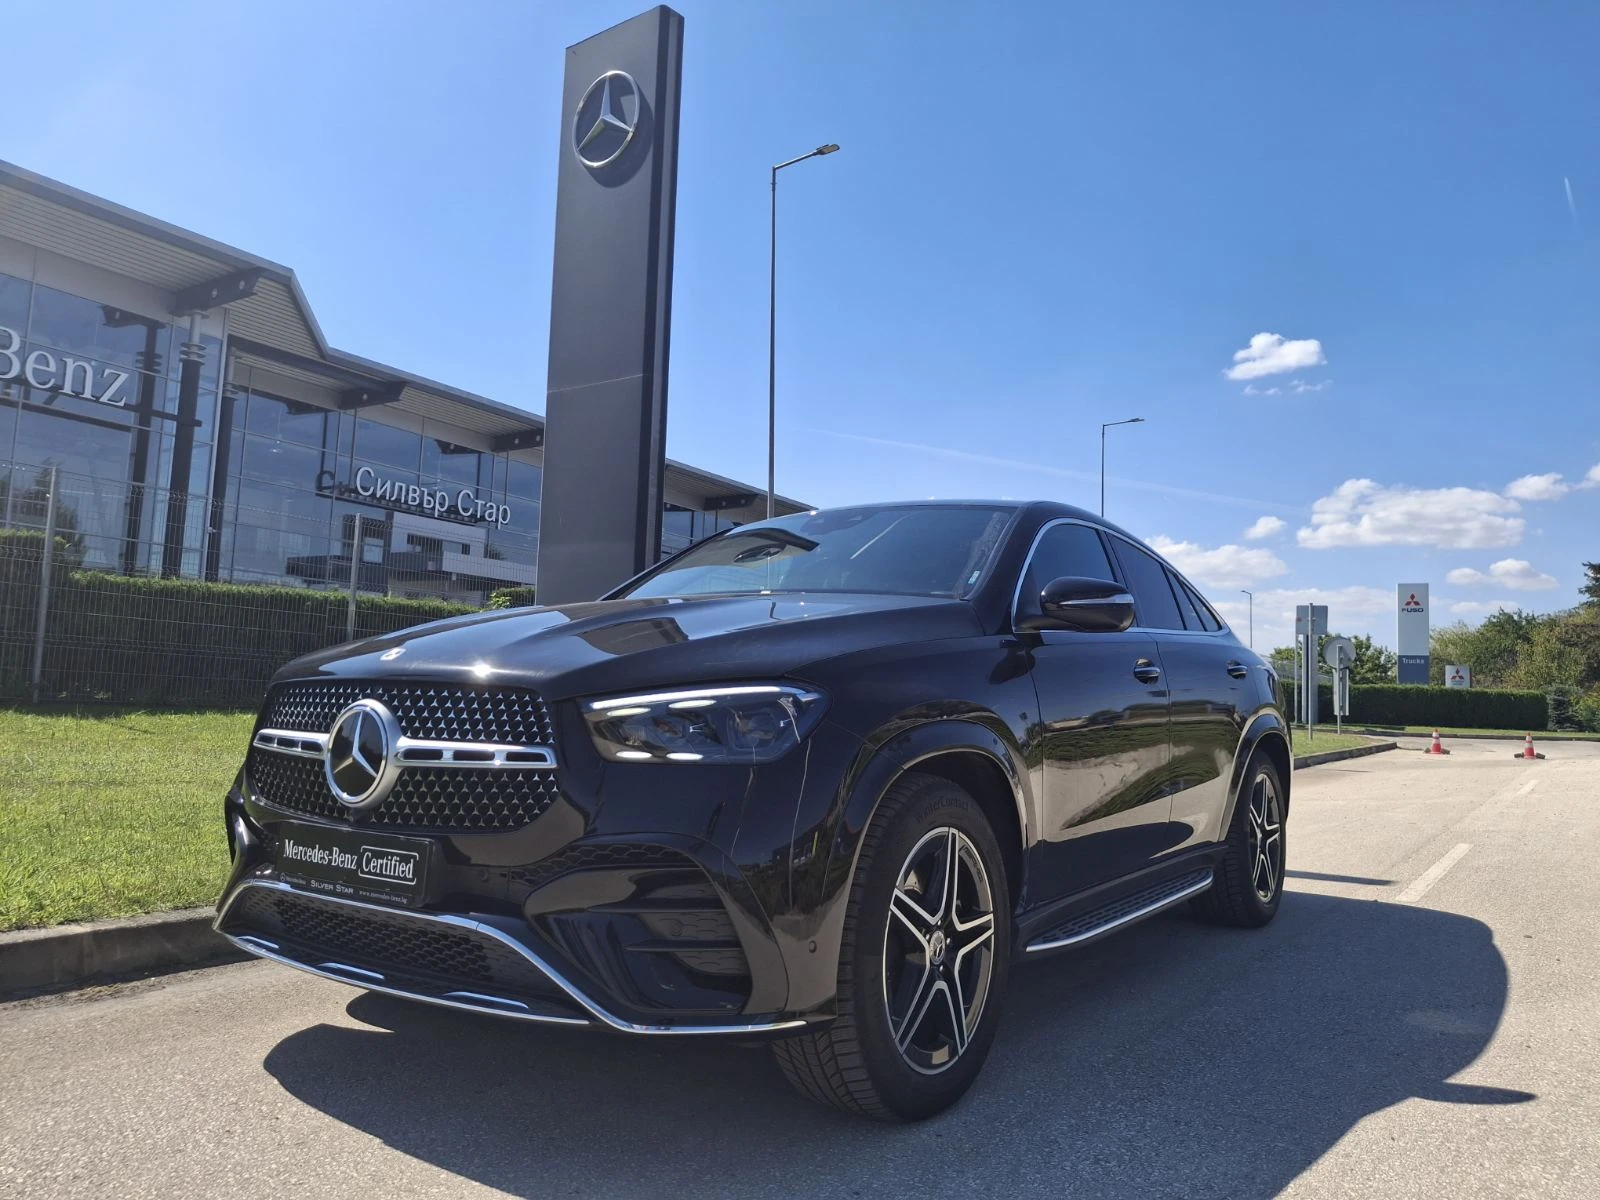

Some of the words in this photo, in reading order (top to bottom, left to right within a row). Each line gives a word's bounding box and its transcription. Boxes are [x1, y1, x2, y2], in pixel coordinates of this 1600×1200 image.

[356, 466, 449, 517] Силвър
[457, 490, 511, 530] Стар
[1402, 657, 1425, 665] Trucks
[283, 839, 358, 870] Mercedes-Benz
[362, 852, 414, 878] Certified
[310, 879, 334, 891] SILVER
[335, 884, 354, 895] STAR
